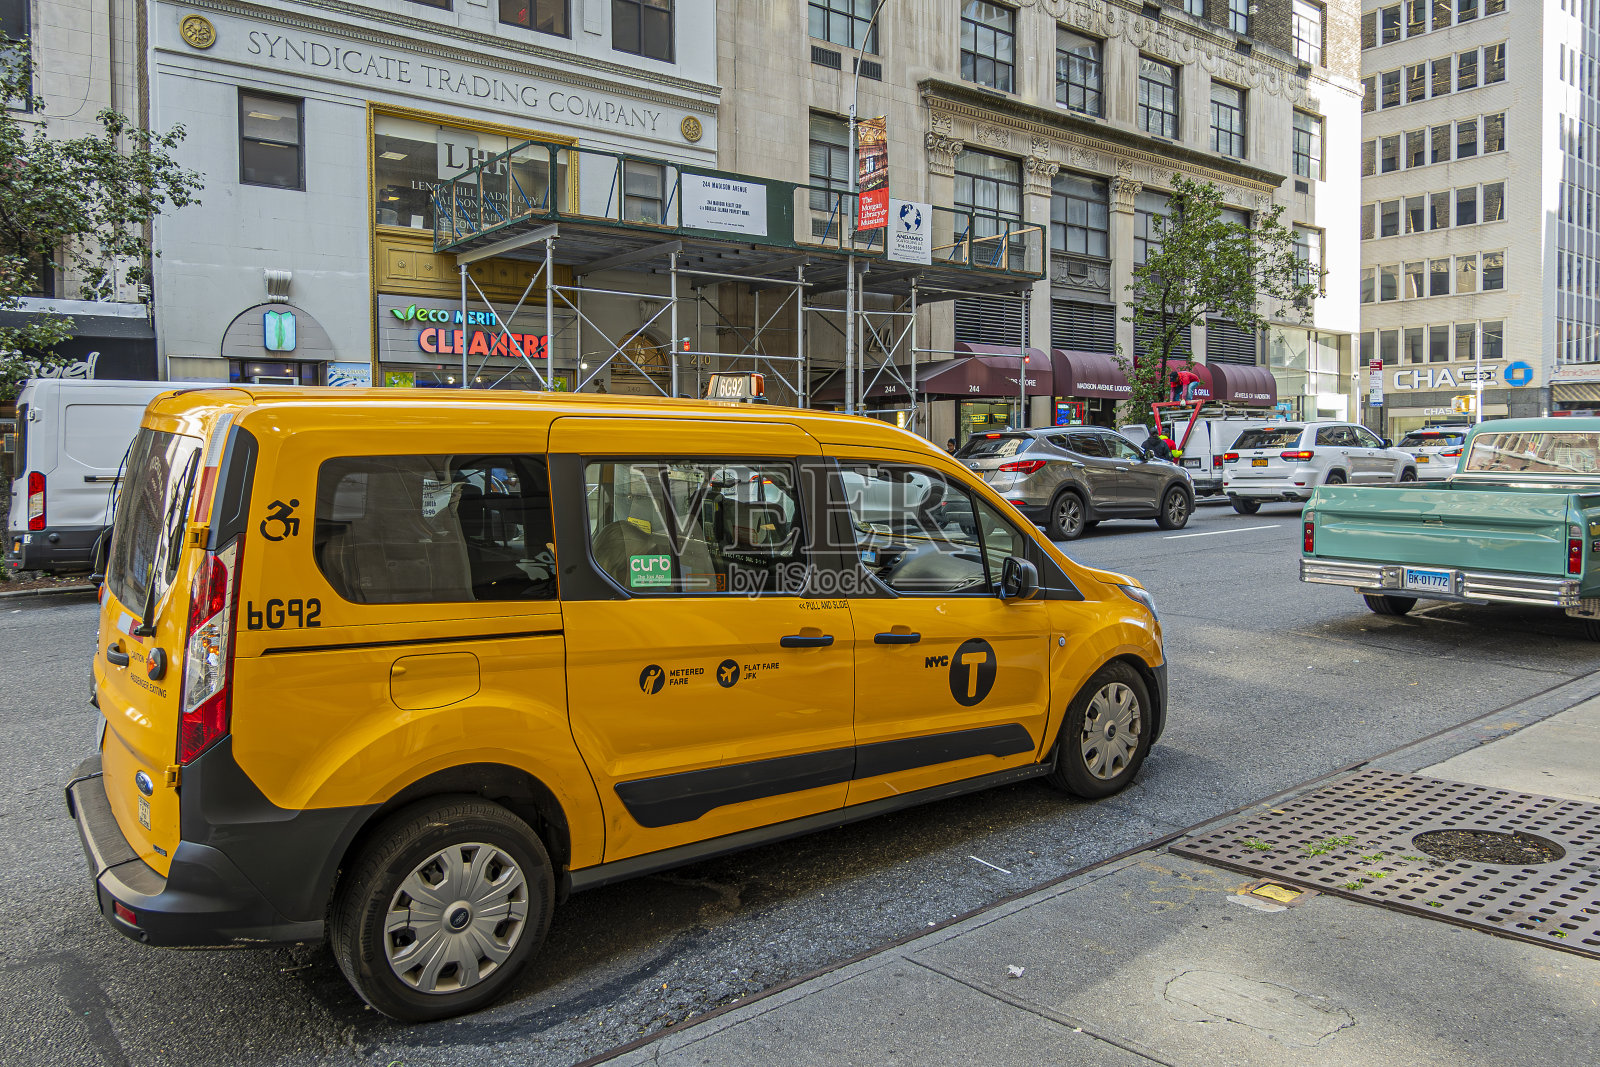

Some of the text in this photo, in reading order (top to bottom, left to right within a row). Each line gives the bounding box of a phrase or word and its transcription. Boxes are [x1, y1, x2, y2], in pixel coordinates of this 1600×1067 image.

[248, 30, 662, 133] SYNDICATE TRADING COMPANY
[711, 181, 731, 191] MADISON
[862, 196, 873, 204] The
[861, 203, 883, 212] Morgan
[861, 210, 881, 219] Library
[860, 217, 885, 226] Museum
[418, 327, 549, 359] CLEANERS
[720, 377, 743, 397] 6G92
[1018, 379, 1037, 387] SORE
[1076, 382, 1097, 390] MADISON
[1097, 383, 1114, 391] AVENUE
[884, 385, 896, 394] 244
[968, 384, 980, 393] 244
[1198, 388, 1210, 396] GRILL
[631, 556, 671, 572] curb
[1408, 574, 1448, 587] BK-01772
[805, 600, 848, 610] PULL AND SLIDE
[744, 662, 780, 671] FLAT FARE
[669, 667, 705, 677] METERED
[744, 672, 757, 680] JFK
[925, 651, 987, 698] NYC T
[669, 677, 689, 686] FARE
[149, 683, 167, 699] EXITING
